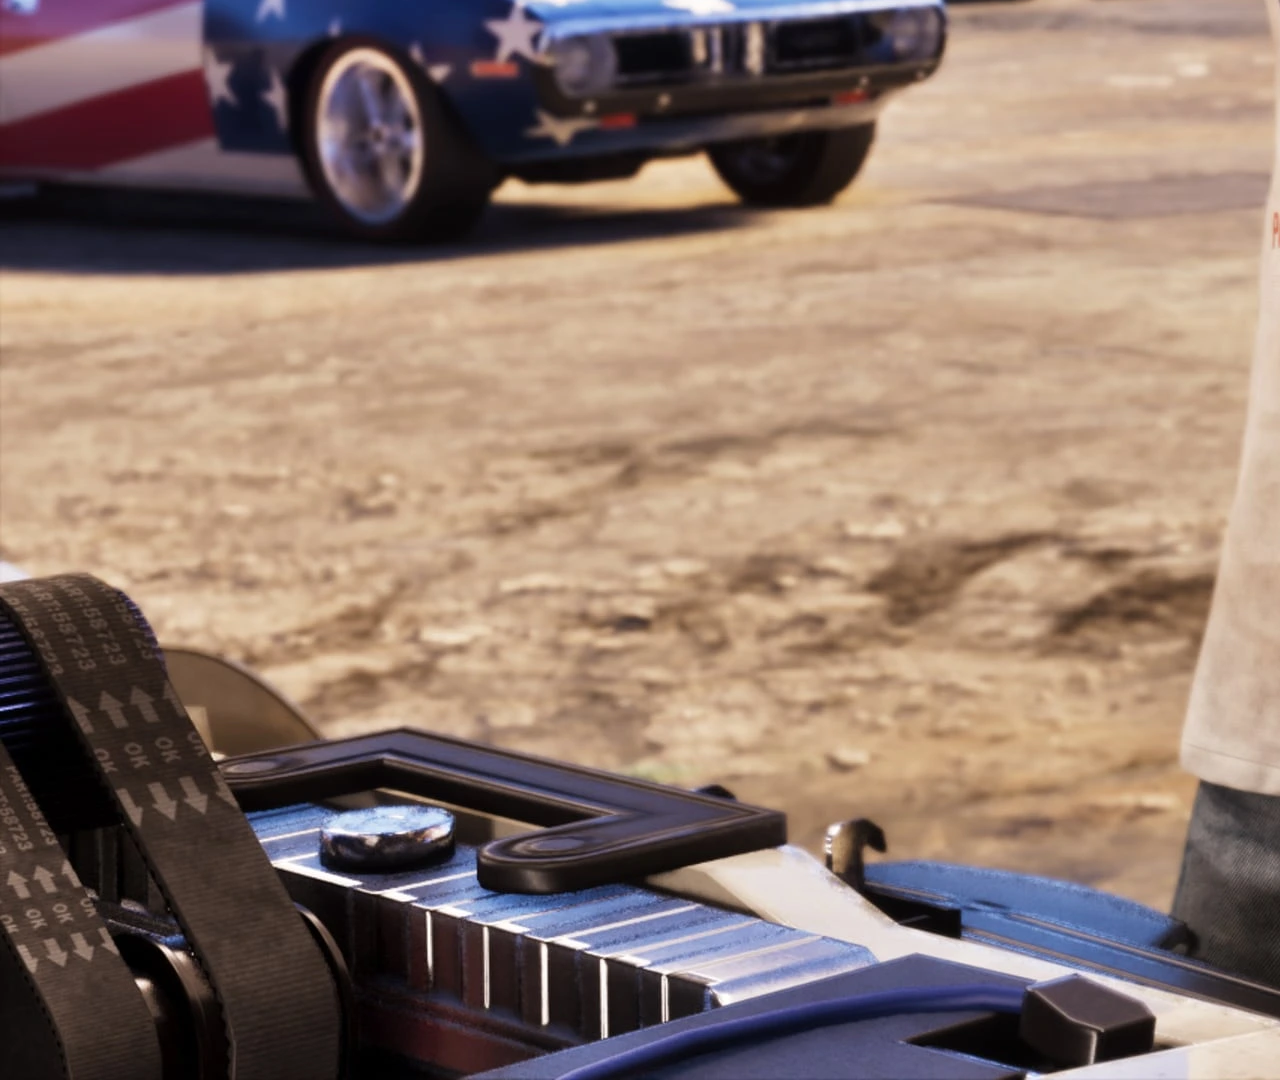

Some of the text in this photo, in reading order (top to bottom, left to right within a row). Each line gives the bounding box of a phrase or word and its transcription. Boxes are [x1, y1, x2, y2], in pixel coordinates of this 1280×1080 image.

[94, 747, 118, 773] OK
[123, 742, 150, 769] OK
[154, 736, 181, 763] OK
[24, 907, 49, 930] OK
[51, 902, 75, 924] OK
